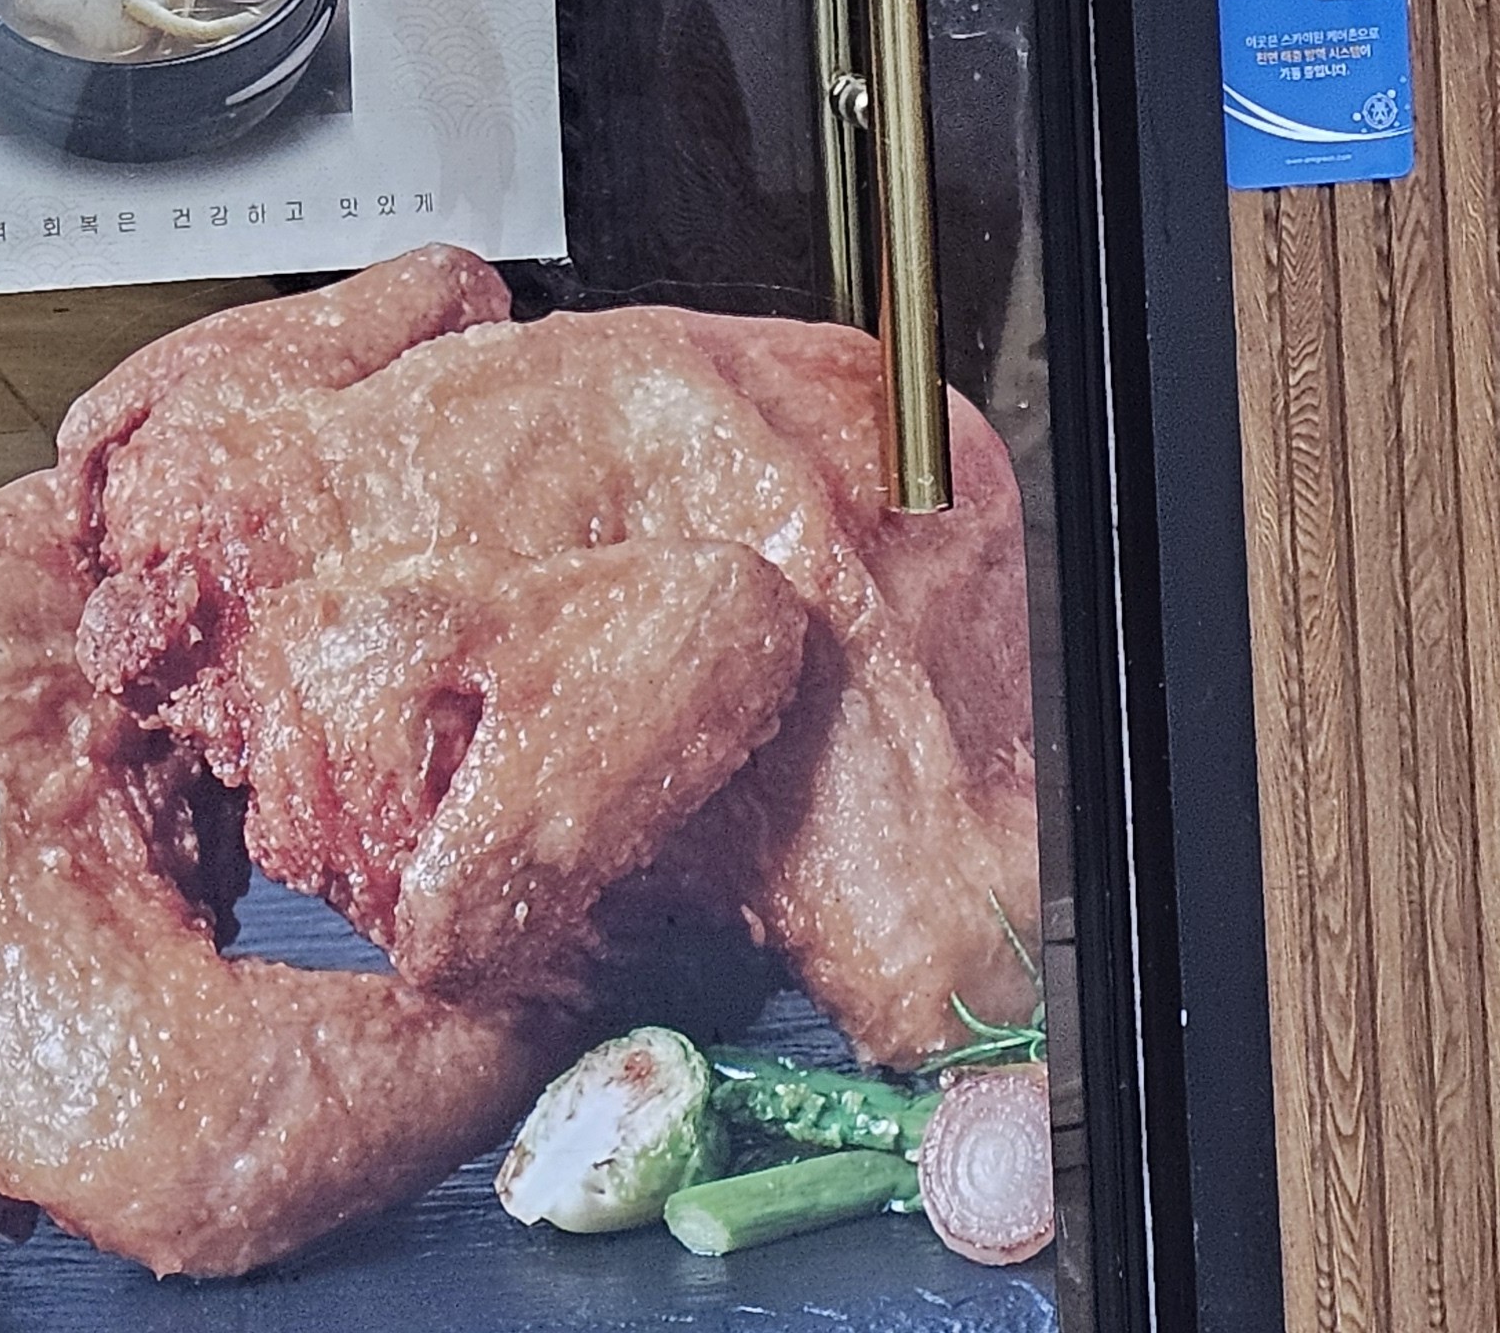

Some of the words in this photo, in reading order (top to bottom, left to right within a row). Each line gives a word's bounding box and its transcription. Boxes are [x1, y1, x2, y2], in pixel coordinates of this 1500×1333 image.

[1245, 35, 1278, 48] 이곳은
[42, 211, 137, 238] 회복은
[172, 200, 304, 229] 건강하고
[339, 192, 434, 219] 맛있게
